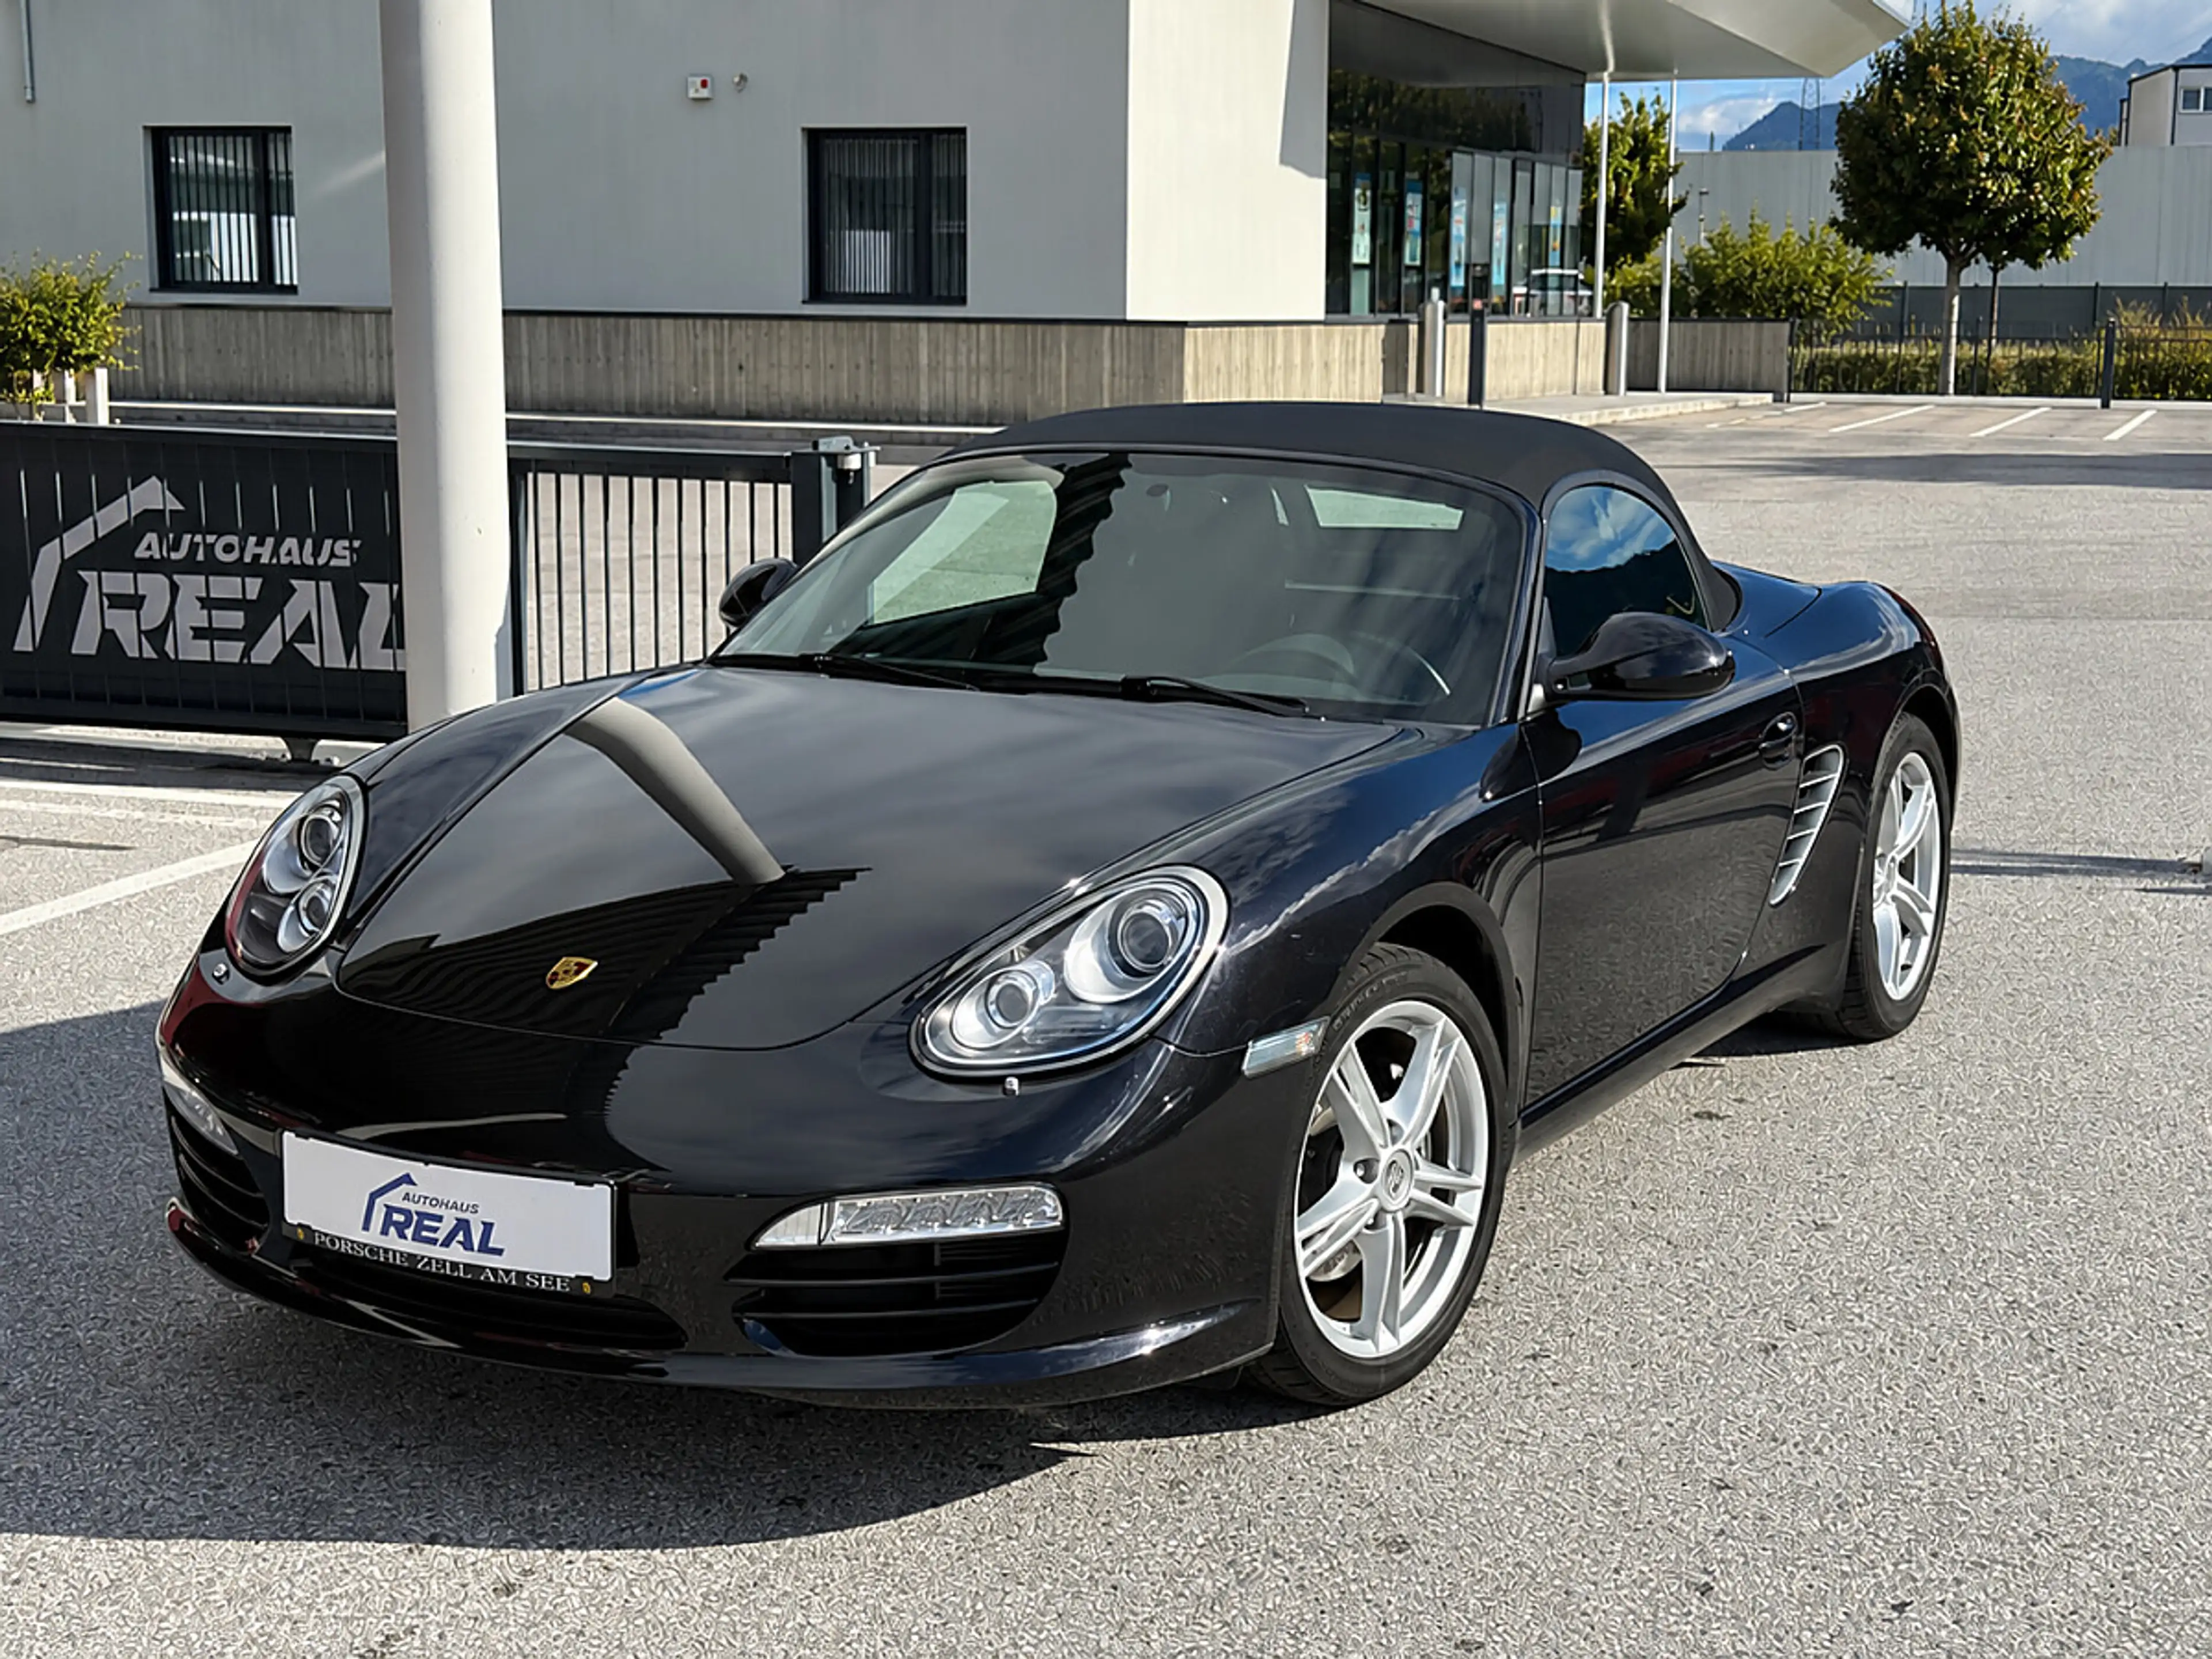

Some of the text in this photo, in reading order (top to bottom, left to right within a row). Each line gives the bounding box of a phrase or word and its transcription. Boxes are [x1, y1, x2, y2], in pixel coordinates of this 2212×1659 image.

[134, 533, 361, 567] AUTOHAUS
[70, 570, 406, 671] REAL
[402, 1192, 479, 1214] AUTOHAUS
[379, 1204, 506, 1257] REAL
[314, 1231, 570, 1293] PORSCHE ZELL AM SEE
